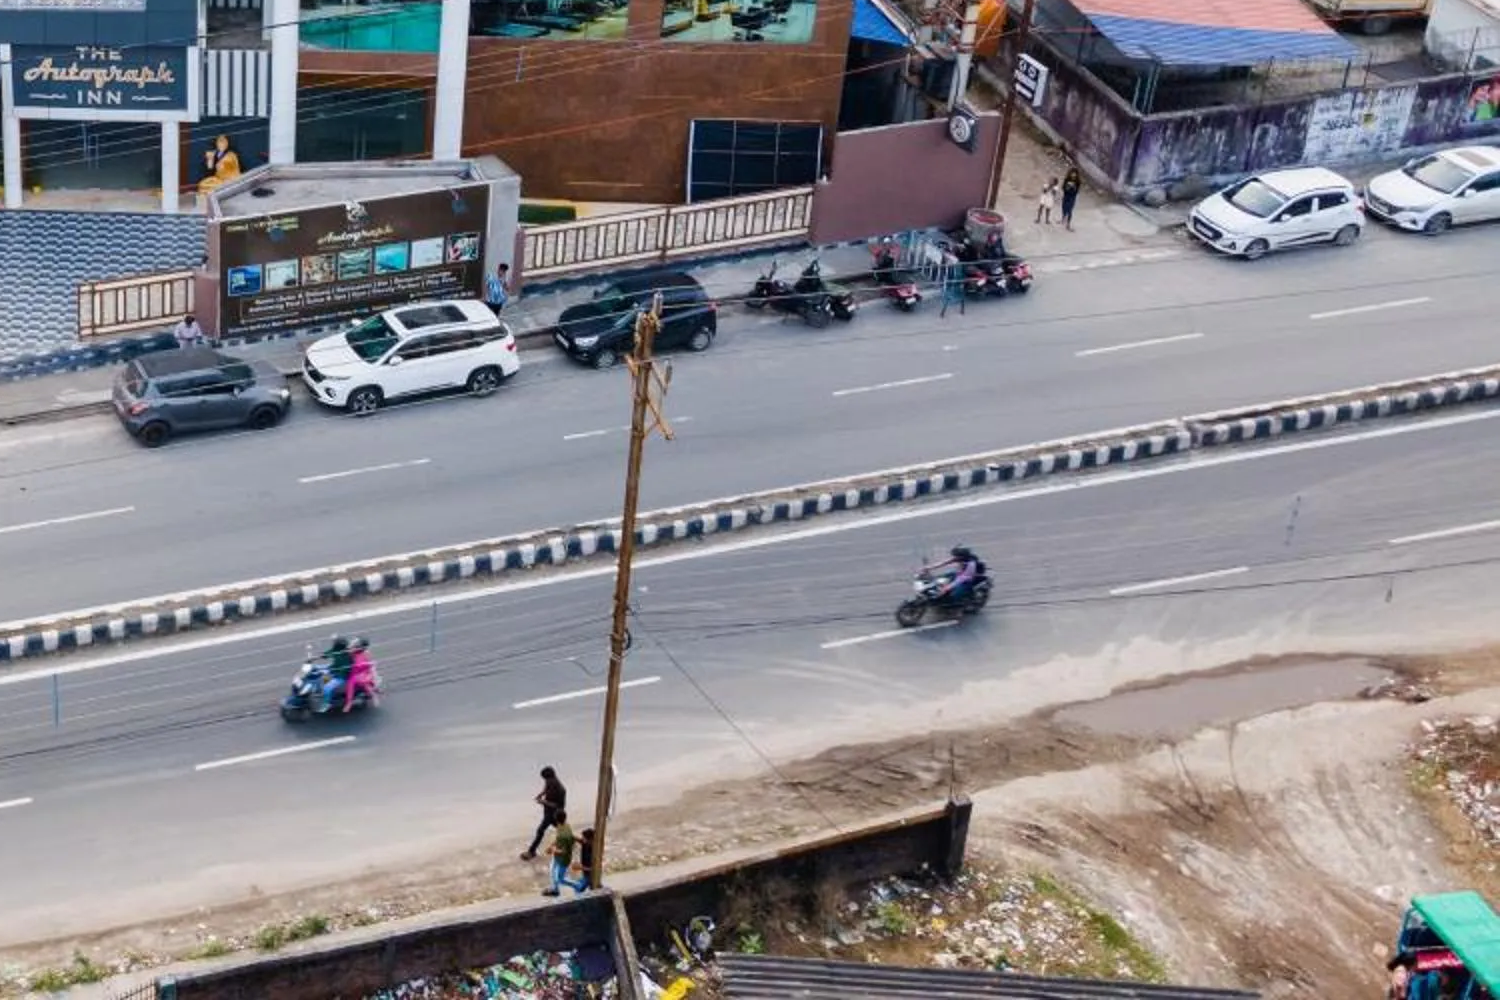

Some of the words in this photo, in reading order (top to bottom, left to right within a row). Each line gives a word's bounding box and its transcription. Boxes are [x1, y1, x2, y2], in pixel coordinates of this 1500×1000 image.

[76, 45, 123, 61] THE
[23, 57, 175, 89] Autograph
[77, 90, 122, 105] INN
